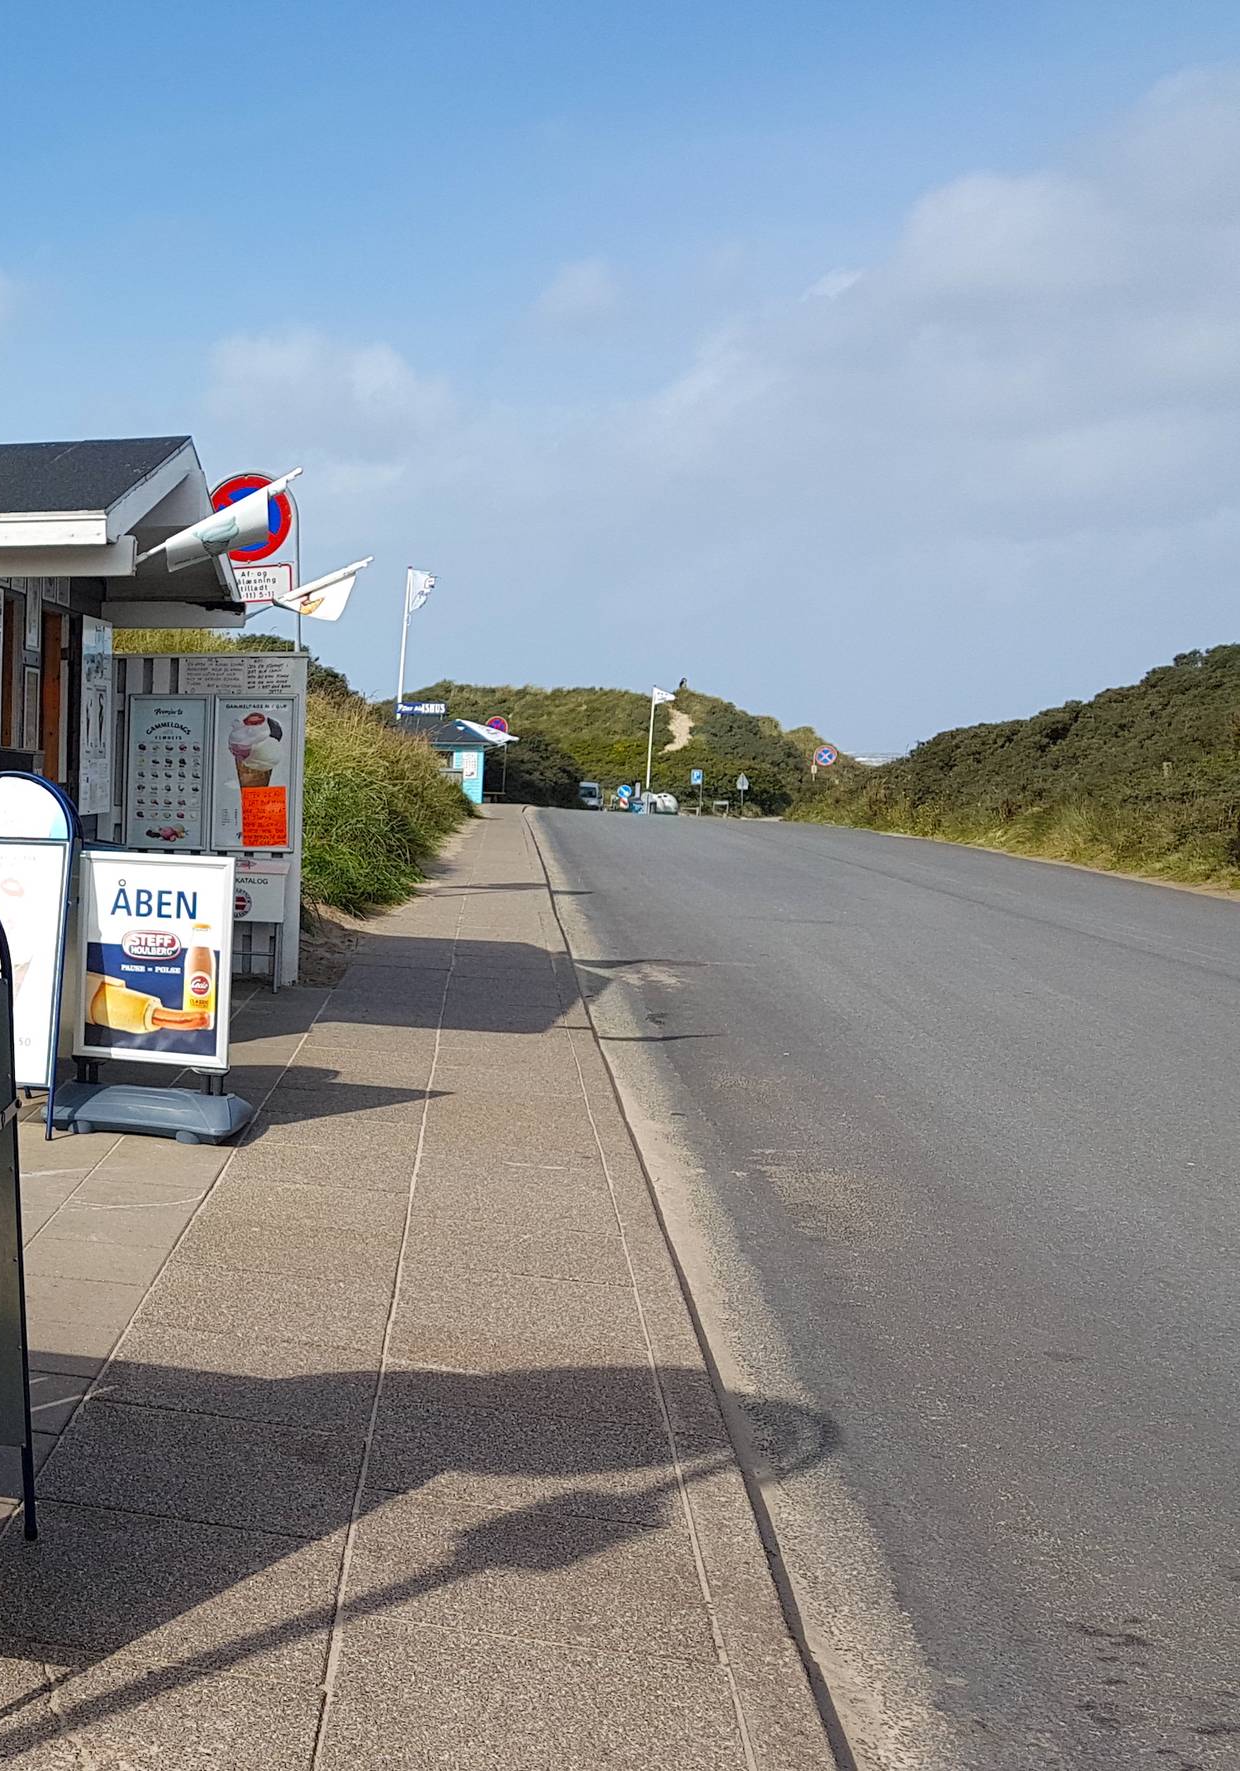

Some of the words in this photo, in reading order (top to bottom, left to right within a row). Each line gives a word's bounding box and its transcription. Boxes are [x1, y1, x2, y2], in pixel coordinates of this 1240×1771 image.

[256, 571, 268, 579] og
[146, 721, 191, 735] GAMMELDAGS
[110, 878, 198, 920] ÅBEN
[130, 933, 172, 947] STEFF
